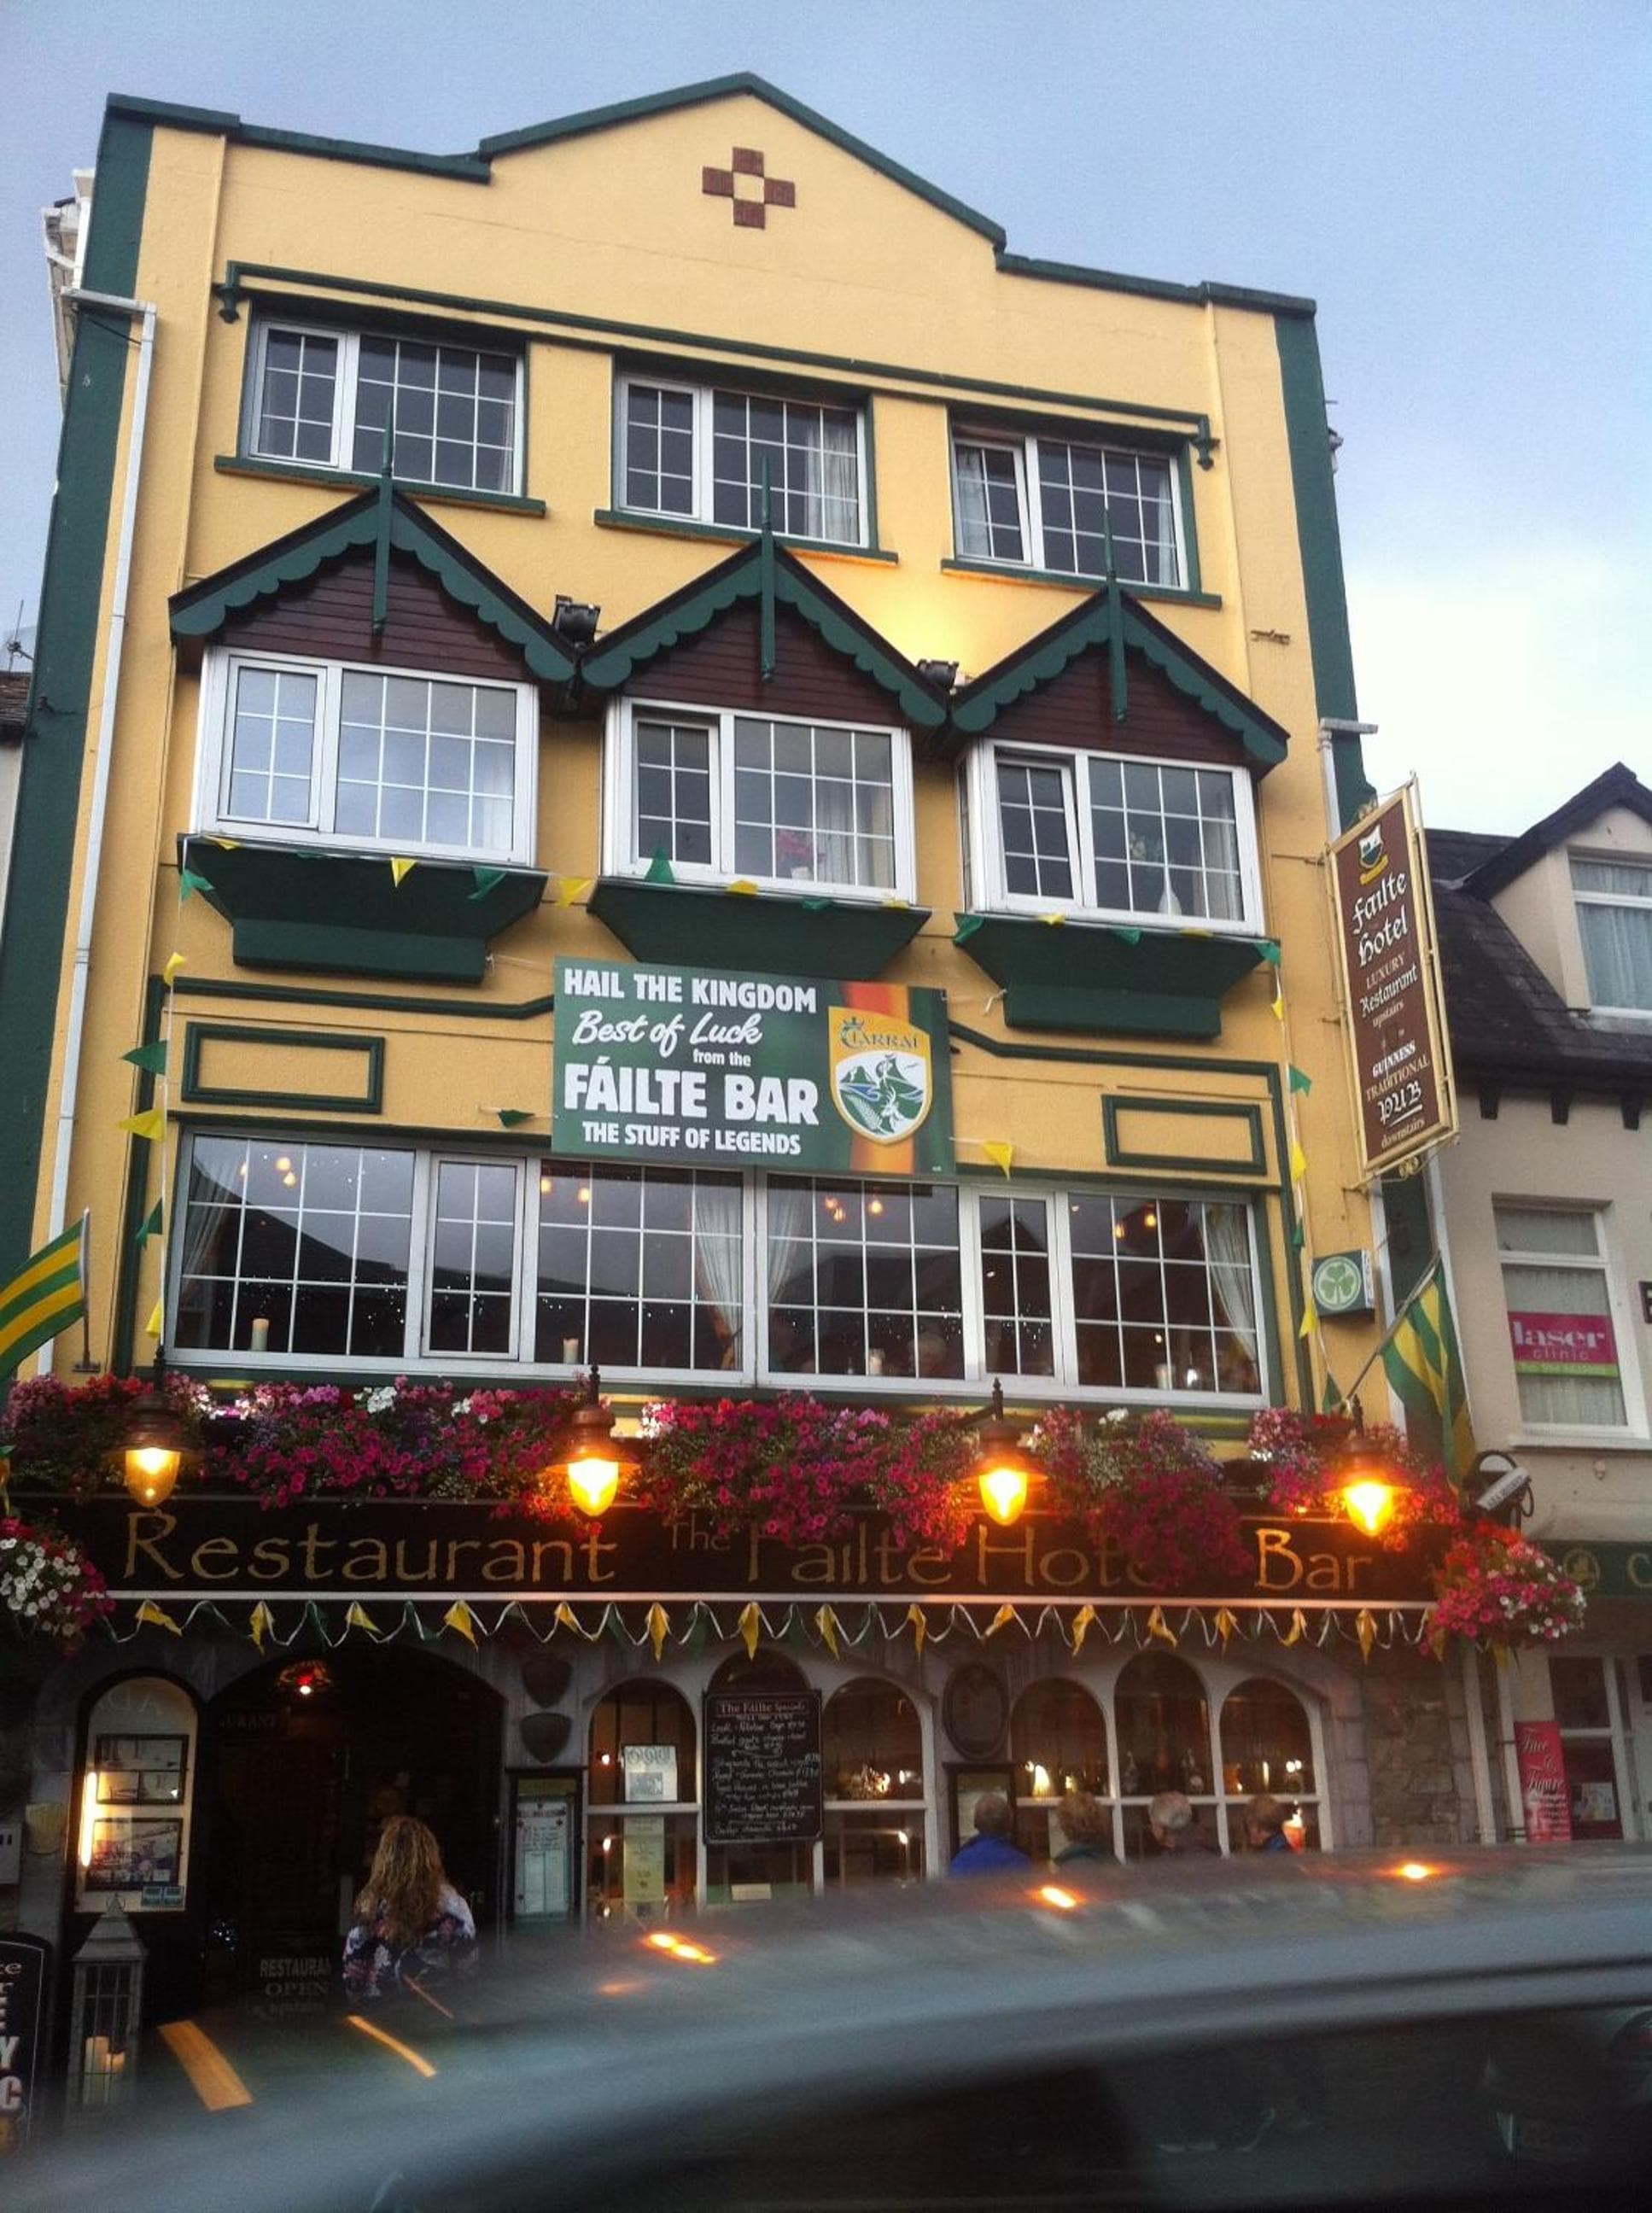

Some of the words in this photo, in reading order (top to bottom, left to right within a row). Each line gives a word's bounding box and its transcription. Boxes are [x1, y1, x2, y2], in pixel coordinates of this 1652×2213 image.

[563, 967, 625, 999] HAIL
[633, 973, 683, 1003] THE
[692, 977, 817, 1013] KINGDOM
[1359, 965, 1418, 1018] Restaurant
[1366, 953, 1405, 989] LUXURY
[572, 1009, 648, 1044] Best
[649, 1014, 686, 1058] of
[689, 1012, 762, 1046] Luck
[693, 1048, 726, 1067] from
[728, 1051, 751, 1068] the
[1366, 1054, 1430, 1102] TRADITIONAL
[1372, 1040, 1416, 1077] GUINNESS
[563, 1056, 707, 1118] FÁILTE
[724, 1073, 820, 1125] BAR
[1378, 1080, 1422, 1124] PUB
[582, 1121, 620, 1144] THE
[624, 1125, 680, 1148] STUFF
[686, 1128, 710, 1150] OF
[715, 1130, 802, 1155] LEGENDS
[1513, 1321, 1605, 1349] laser
[123, 1509, 617, 1583] Restaurant
[978, 1523, 1163, 1588] Hote
[1253, 1527, 1373, 1591] Bar
